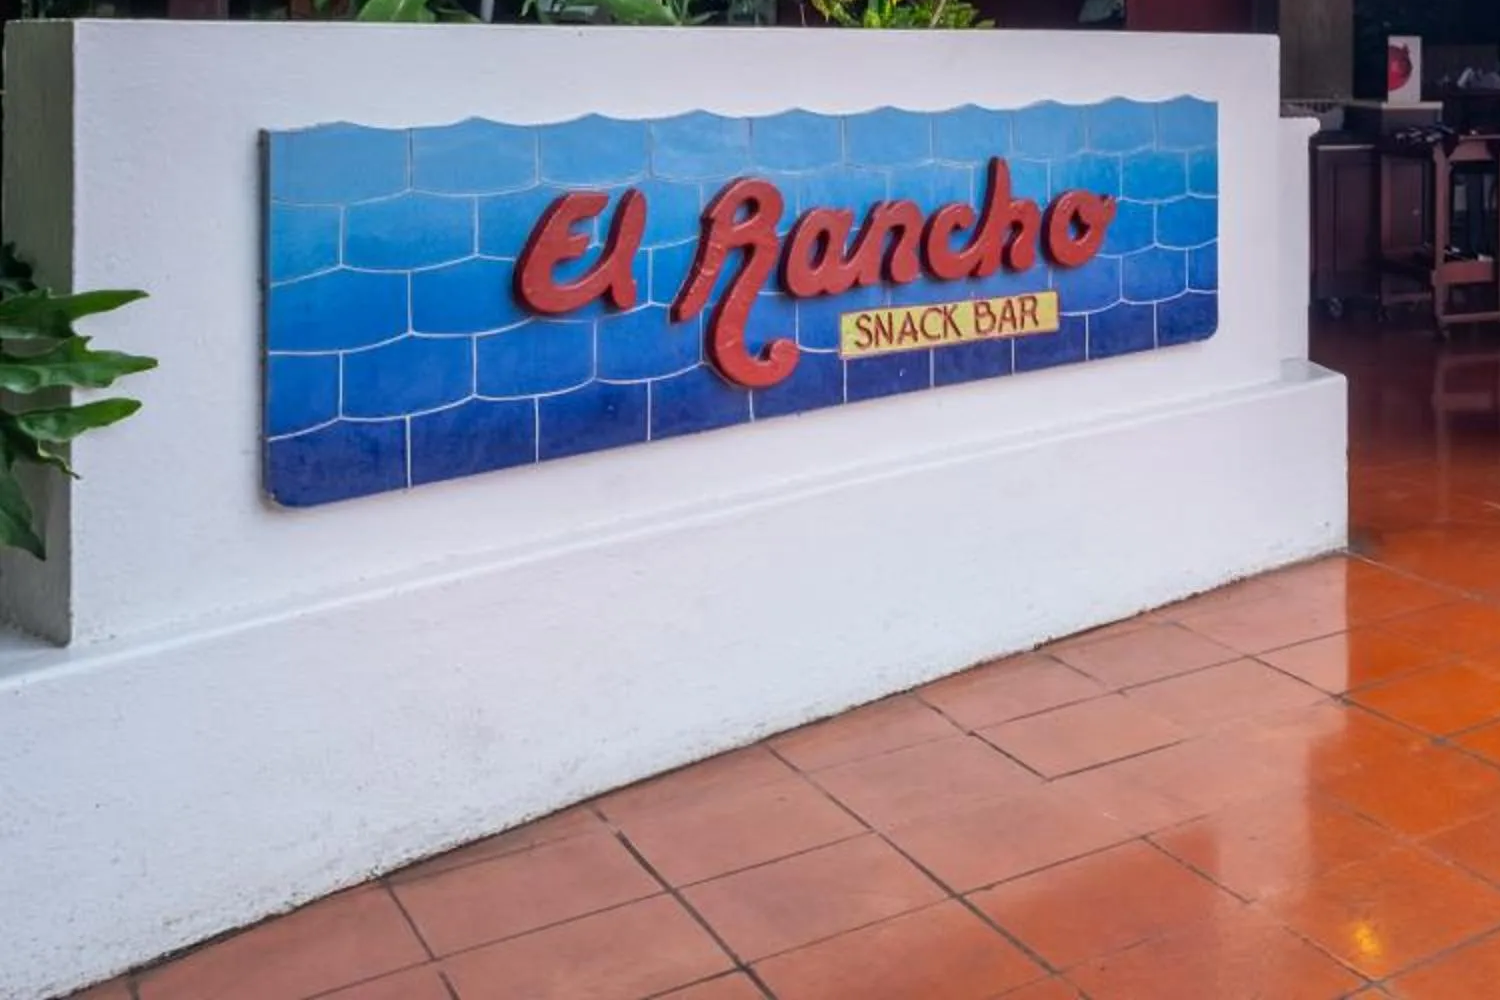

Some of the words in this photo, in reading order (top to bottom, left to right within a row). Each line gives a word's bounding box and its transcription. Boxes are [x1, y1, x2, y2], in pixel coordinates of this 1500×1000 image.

[512, 187, 647, 317] El
[669, 156, 1116, 389] Rancho
[854, 305, 962, 349] SNACK
[973, 295, 1040, 334] BAR
